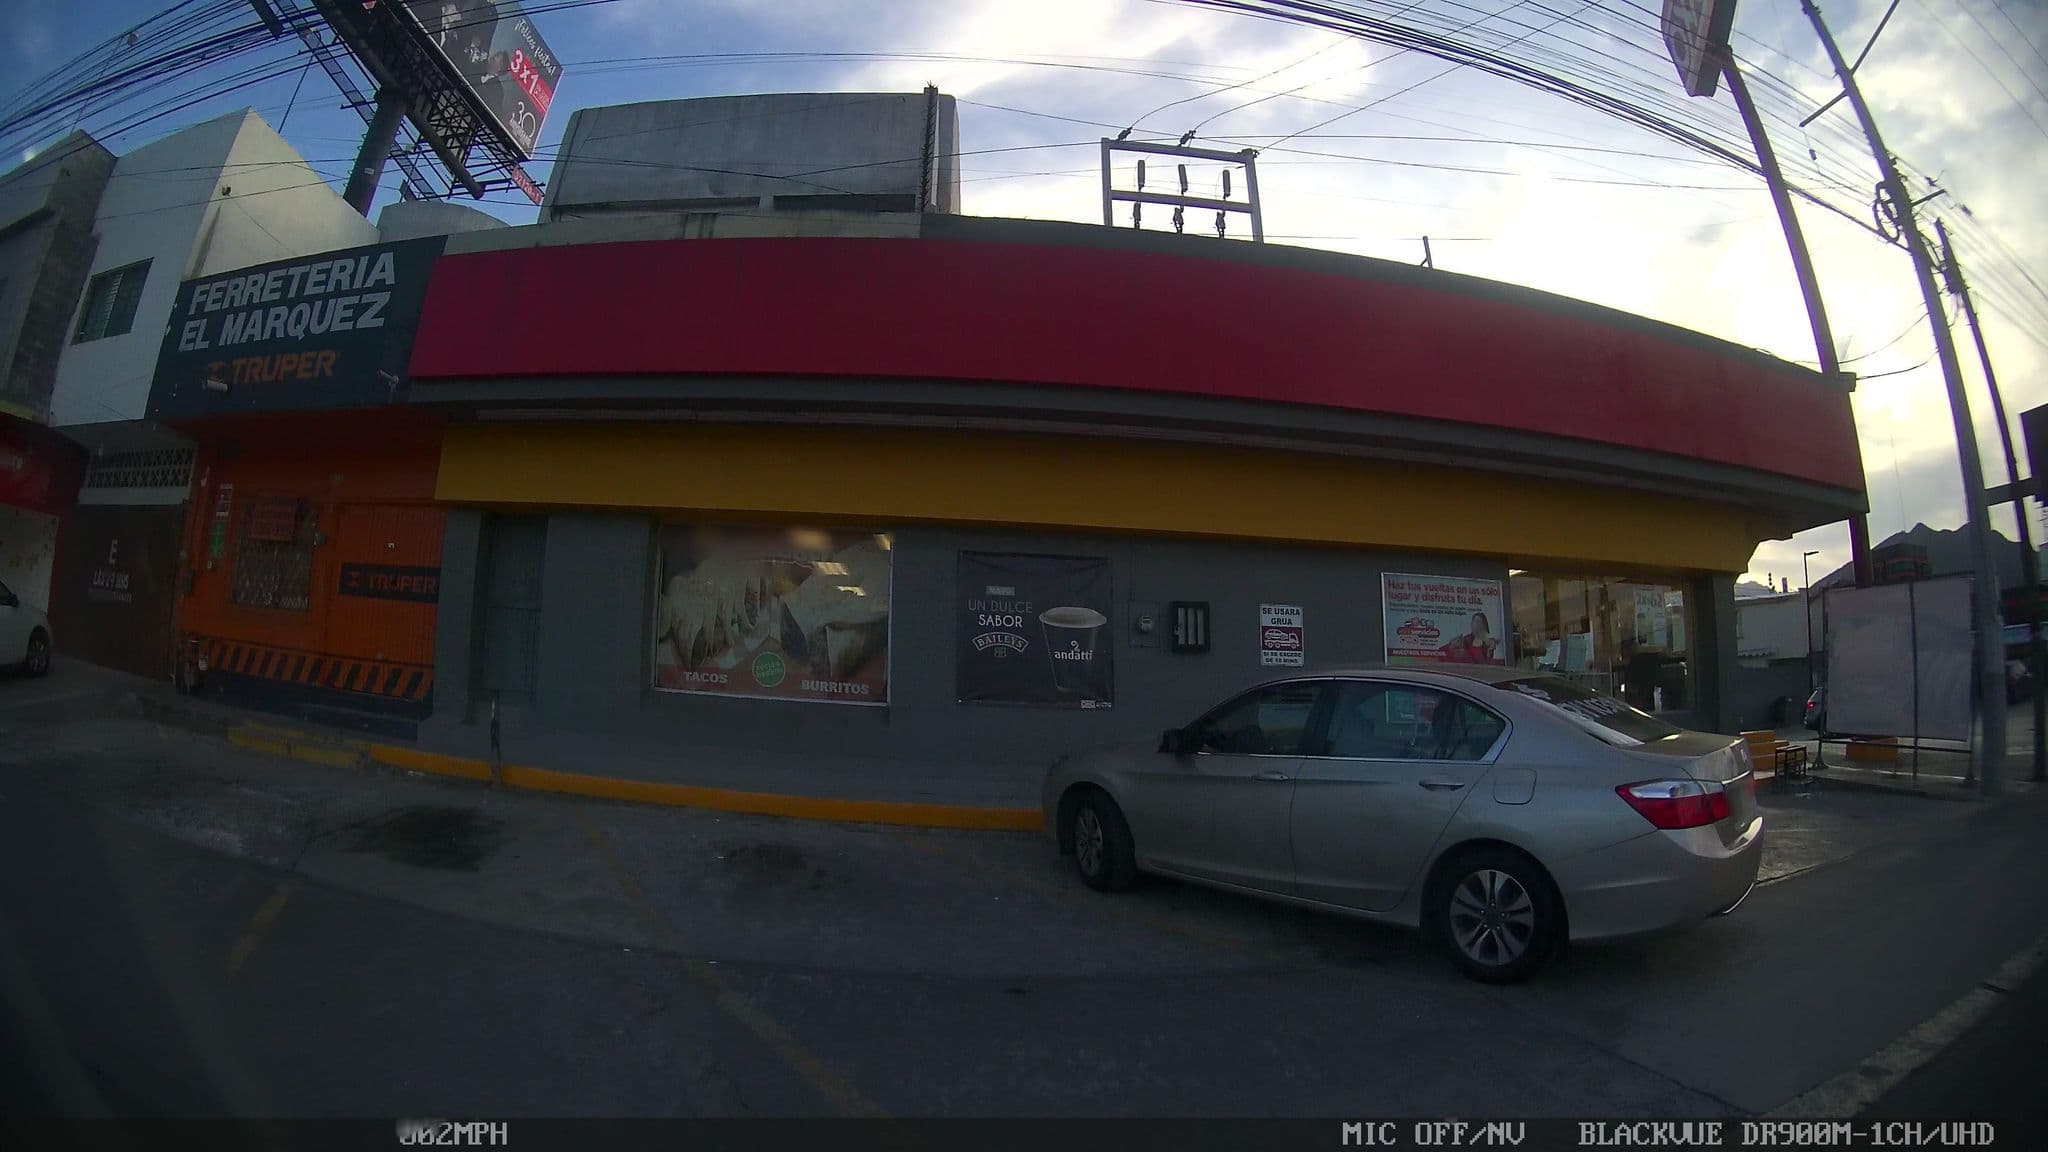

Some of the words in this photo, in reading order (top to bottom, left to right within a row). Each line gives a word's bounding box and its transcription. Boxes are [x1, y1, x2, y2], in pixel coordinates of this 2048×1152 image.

[188, 251, 396, 316] FERRETERIA
[178, 318, 210, 353] EL
[218, 291, 392, 346] MARQUEZ
[231, 350, 337, 385] TRUPER
[367, 574, 438, 595] TRUPER
[1388, 579, 1405, 590] Haz
[1408, 581, 1421, 591] tus
[1424, 582, 1454, 593] vueltas
[1457, 586, 1467, 594] en
[1481, 586, 1498, 597] sólo
[968, 599, 986, 611] UN
[991, 600, 1033, 613] DULCE
[1389, 591, 1412, 602] lugar
[1414, 593, 1419, 601] y
[1422, 592, 1456, 603] disfruta
[1457, 595, 1467, 604] tu
[1262, 607, 1272, 615] SE
[1274, 607, 1300, 616] USARA
[978, 614, 1023, 628] SABOR
[976, 634, 1025, 650] BAILEYS
[1053, 649, 1094, 661] andatti
[683, 671, 729, 684] TACOS
[800, 679, 871, 695] BURRITOS
